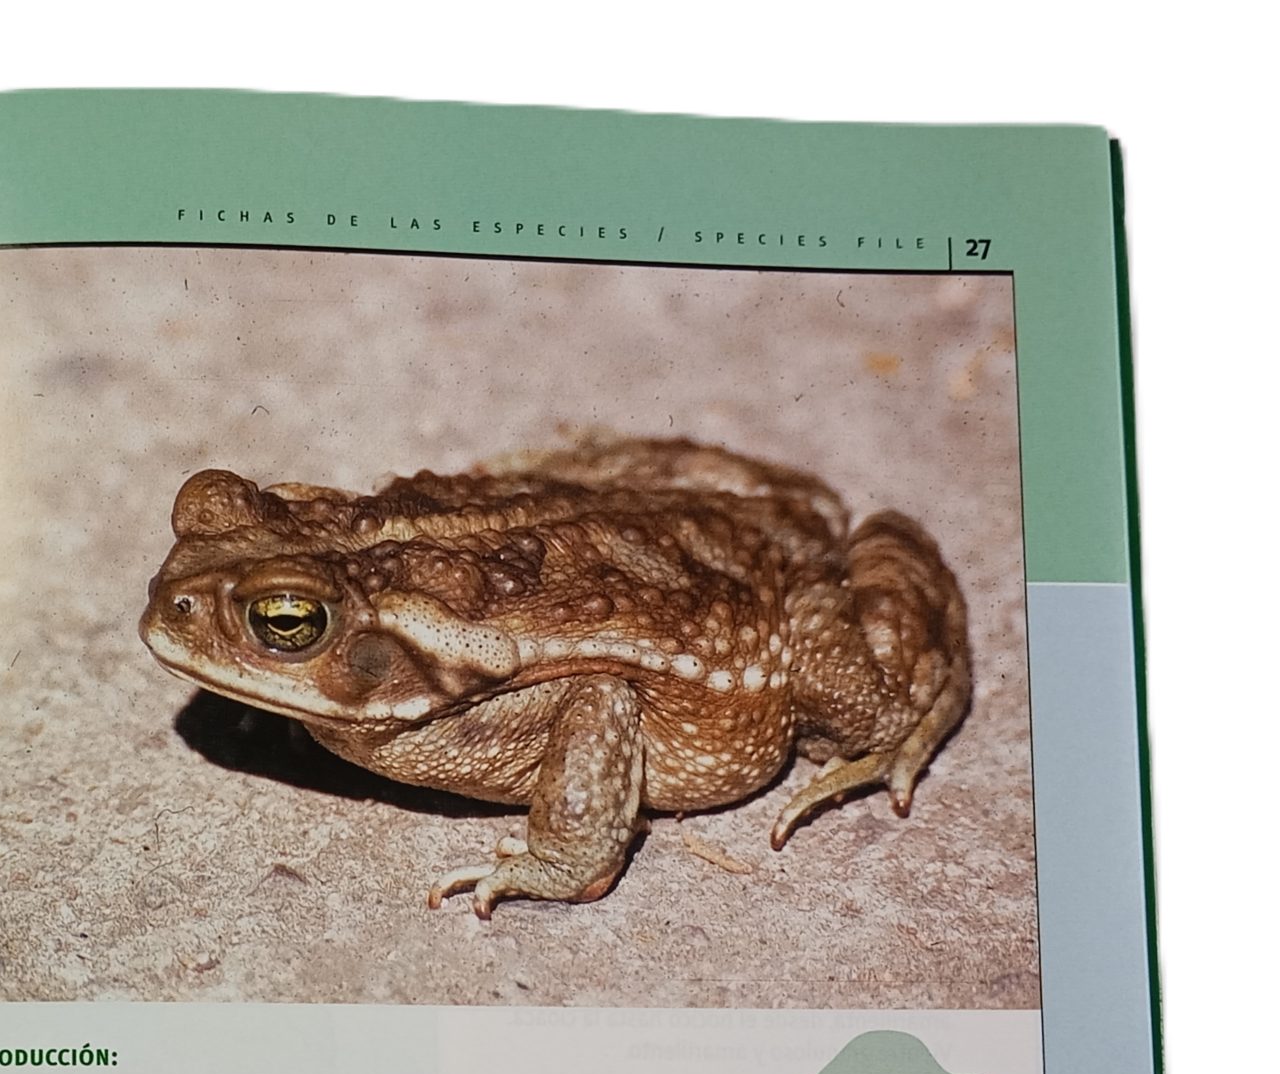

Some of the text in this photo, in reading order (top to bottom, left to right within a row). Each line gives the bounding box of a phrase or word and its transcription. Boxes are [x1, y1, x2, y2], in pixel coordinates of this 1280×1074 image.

[178, 209, 295, 223] FICHAS
[327, 214, 358, 226] DE
[390, 217, 441, 230] LAS
[472, 221, 627, 240] ESPECIES
[694, 231, 827, 247] SPECIES
[858, 237, 924, 249] FILE
[965, 239, 991, 259] 27
